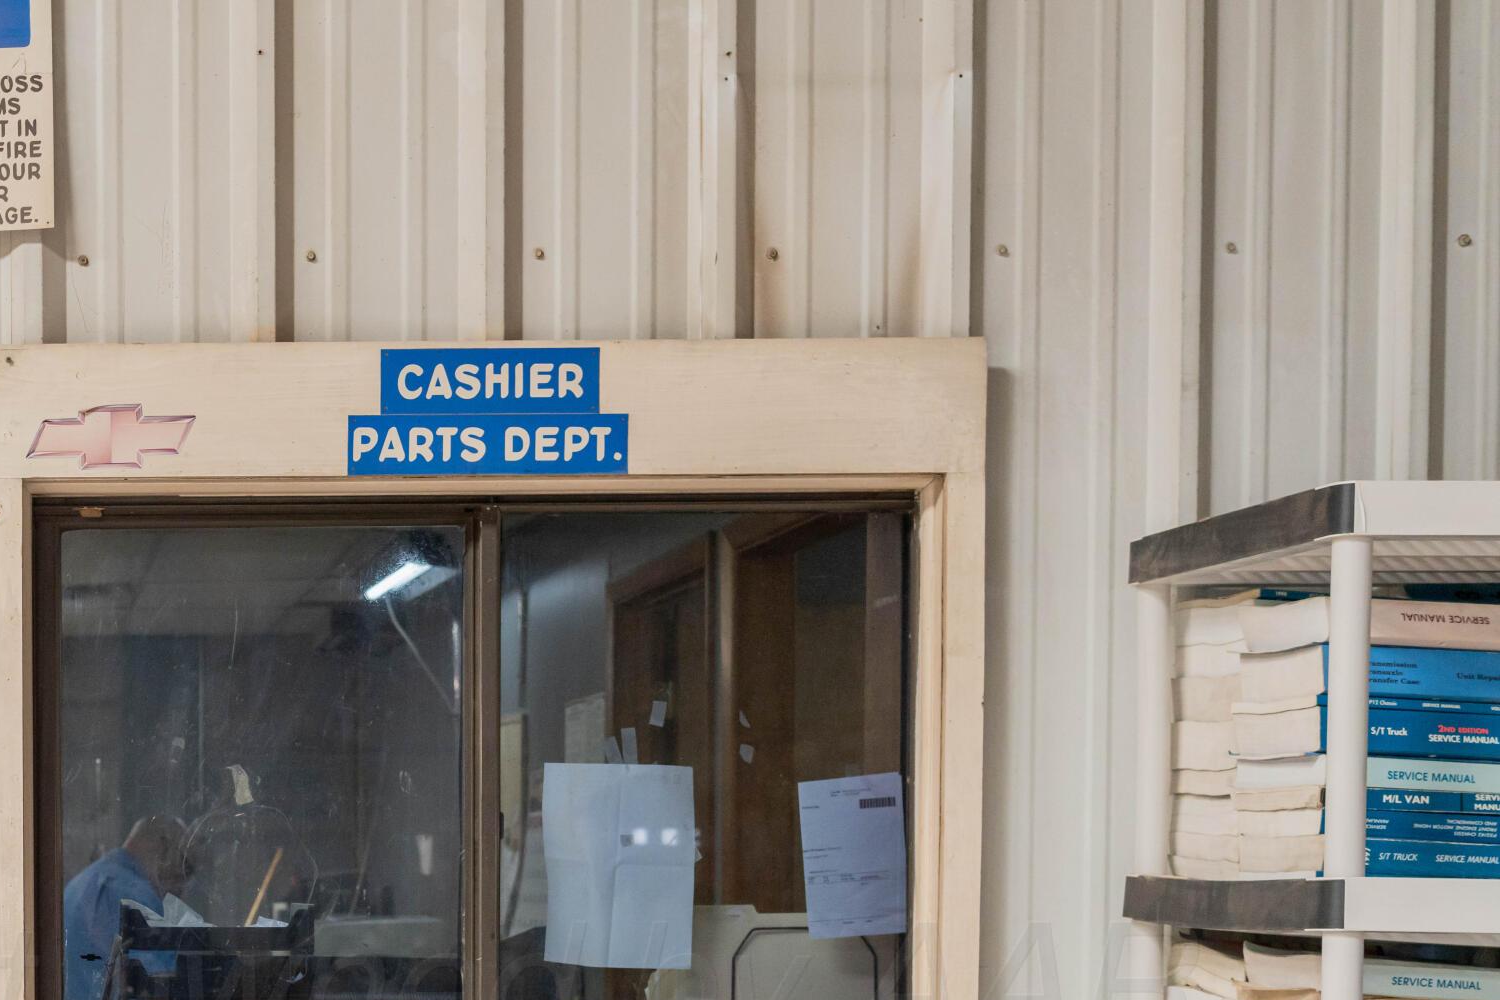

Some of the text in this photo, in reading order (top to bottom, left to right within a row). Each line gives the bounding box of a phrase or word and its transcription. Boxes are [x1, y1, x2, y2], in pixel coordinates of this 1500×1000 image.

[17, 119, 37, 136] IN
[397, 362, 584, 400] CASHIER
[352, 425, 623, 463] PARTS DEPT.
[1401, 613, 1490, 625] SERVICE MANUAL
[1371, 727, 1499, 744] S/T Truck SERVICE MANUAL
[1387, 771, 1476, 783] SERVICE MANUAL
[1383, 794, 1430, 804] M/L VAN
[1393, 853, 1418, 861] TRUCK
[1436, 855, 1466, 863] SERVICE
[1467, 856, 1499, 864] MANUAL
[1391, 976, 1482, 990] SERVICE MANUAL
